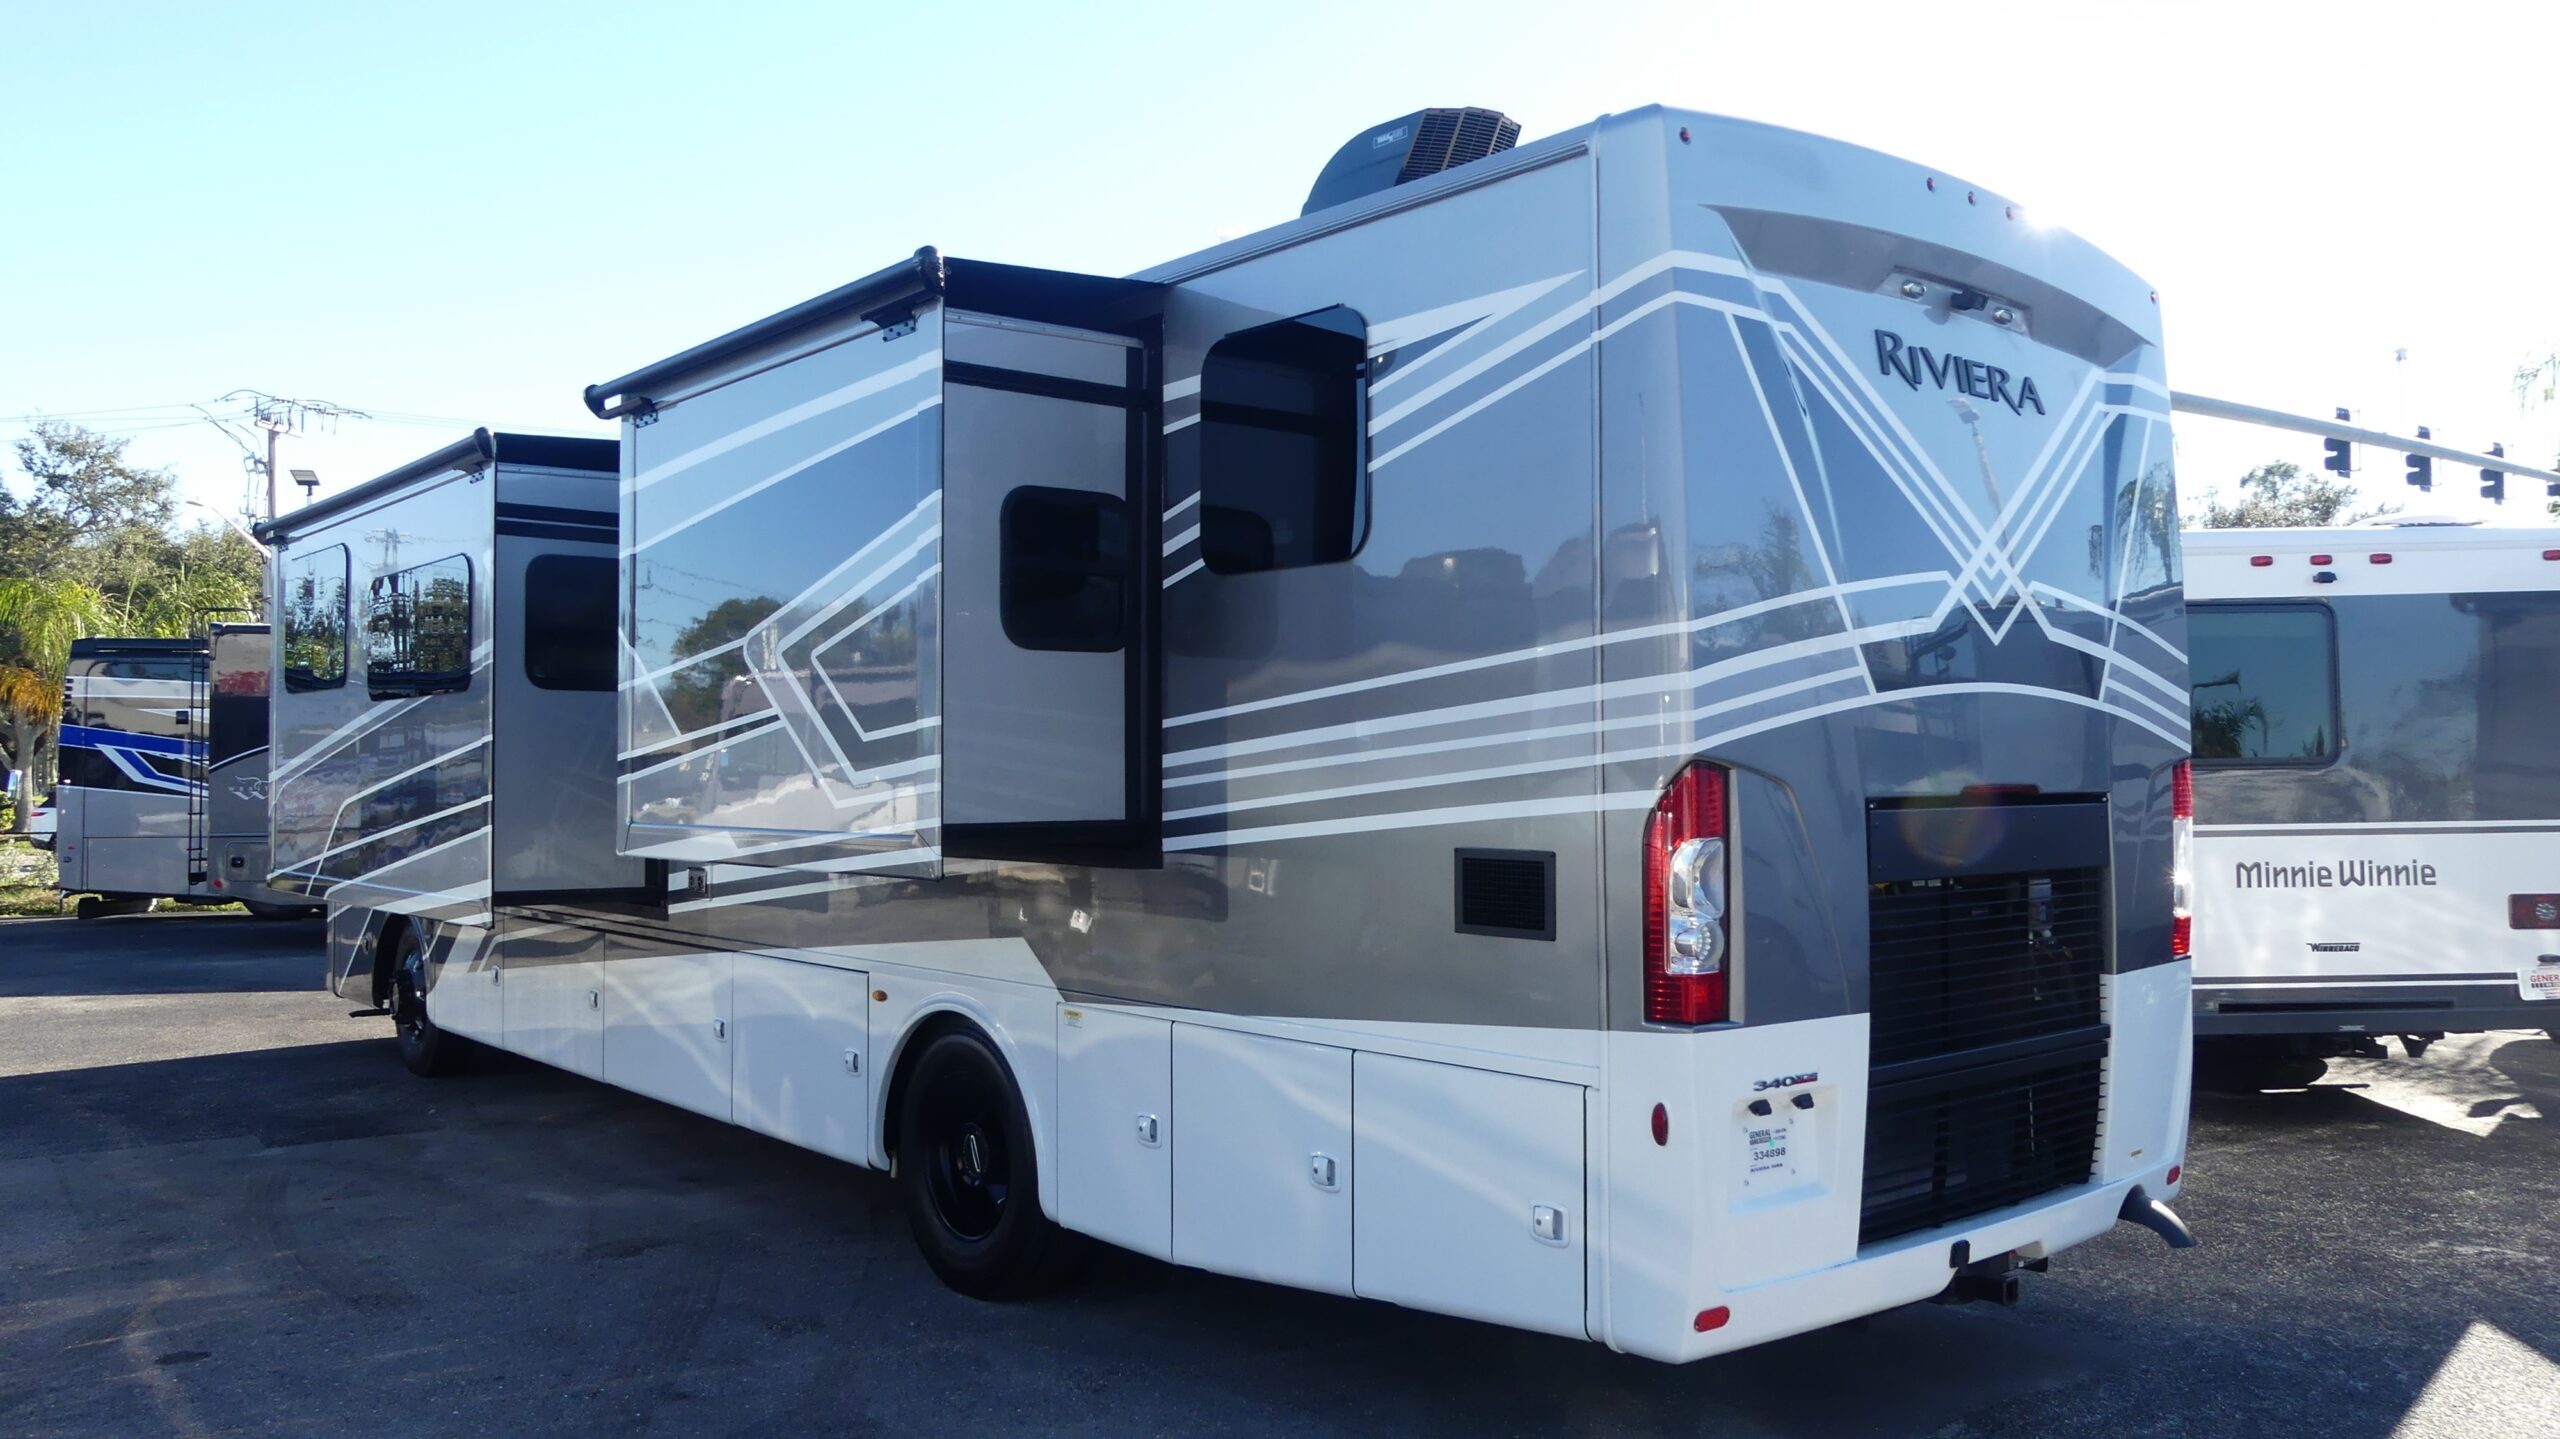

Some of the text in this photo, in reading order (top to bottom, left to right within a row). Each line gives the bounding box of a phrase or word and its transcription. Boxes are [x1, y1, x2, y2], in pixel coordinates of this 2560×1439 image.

[1874, 329, 2046, 417] RIVIERA
[2236, 859, 2437, 888] Minnie Winnie
